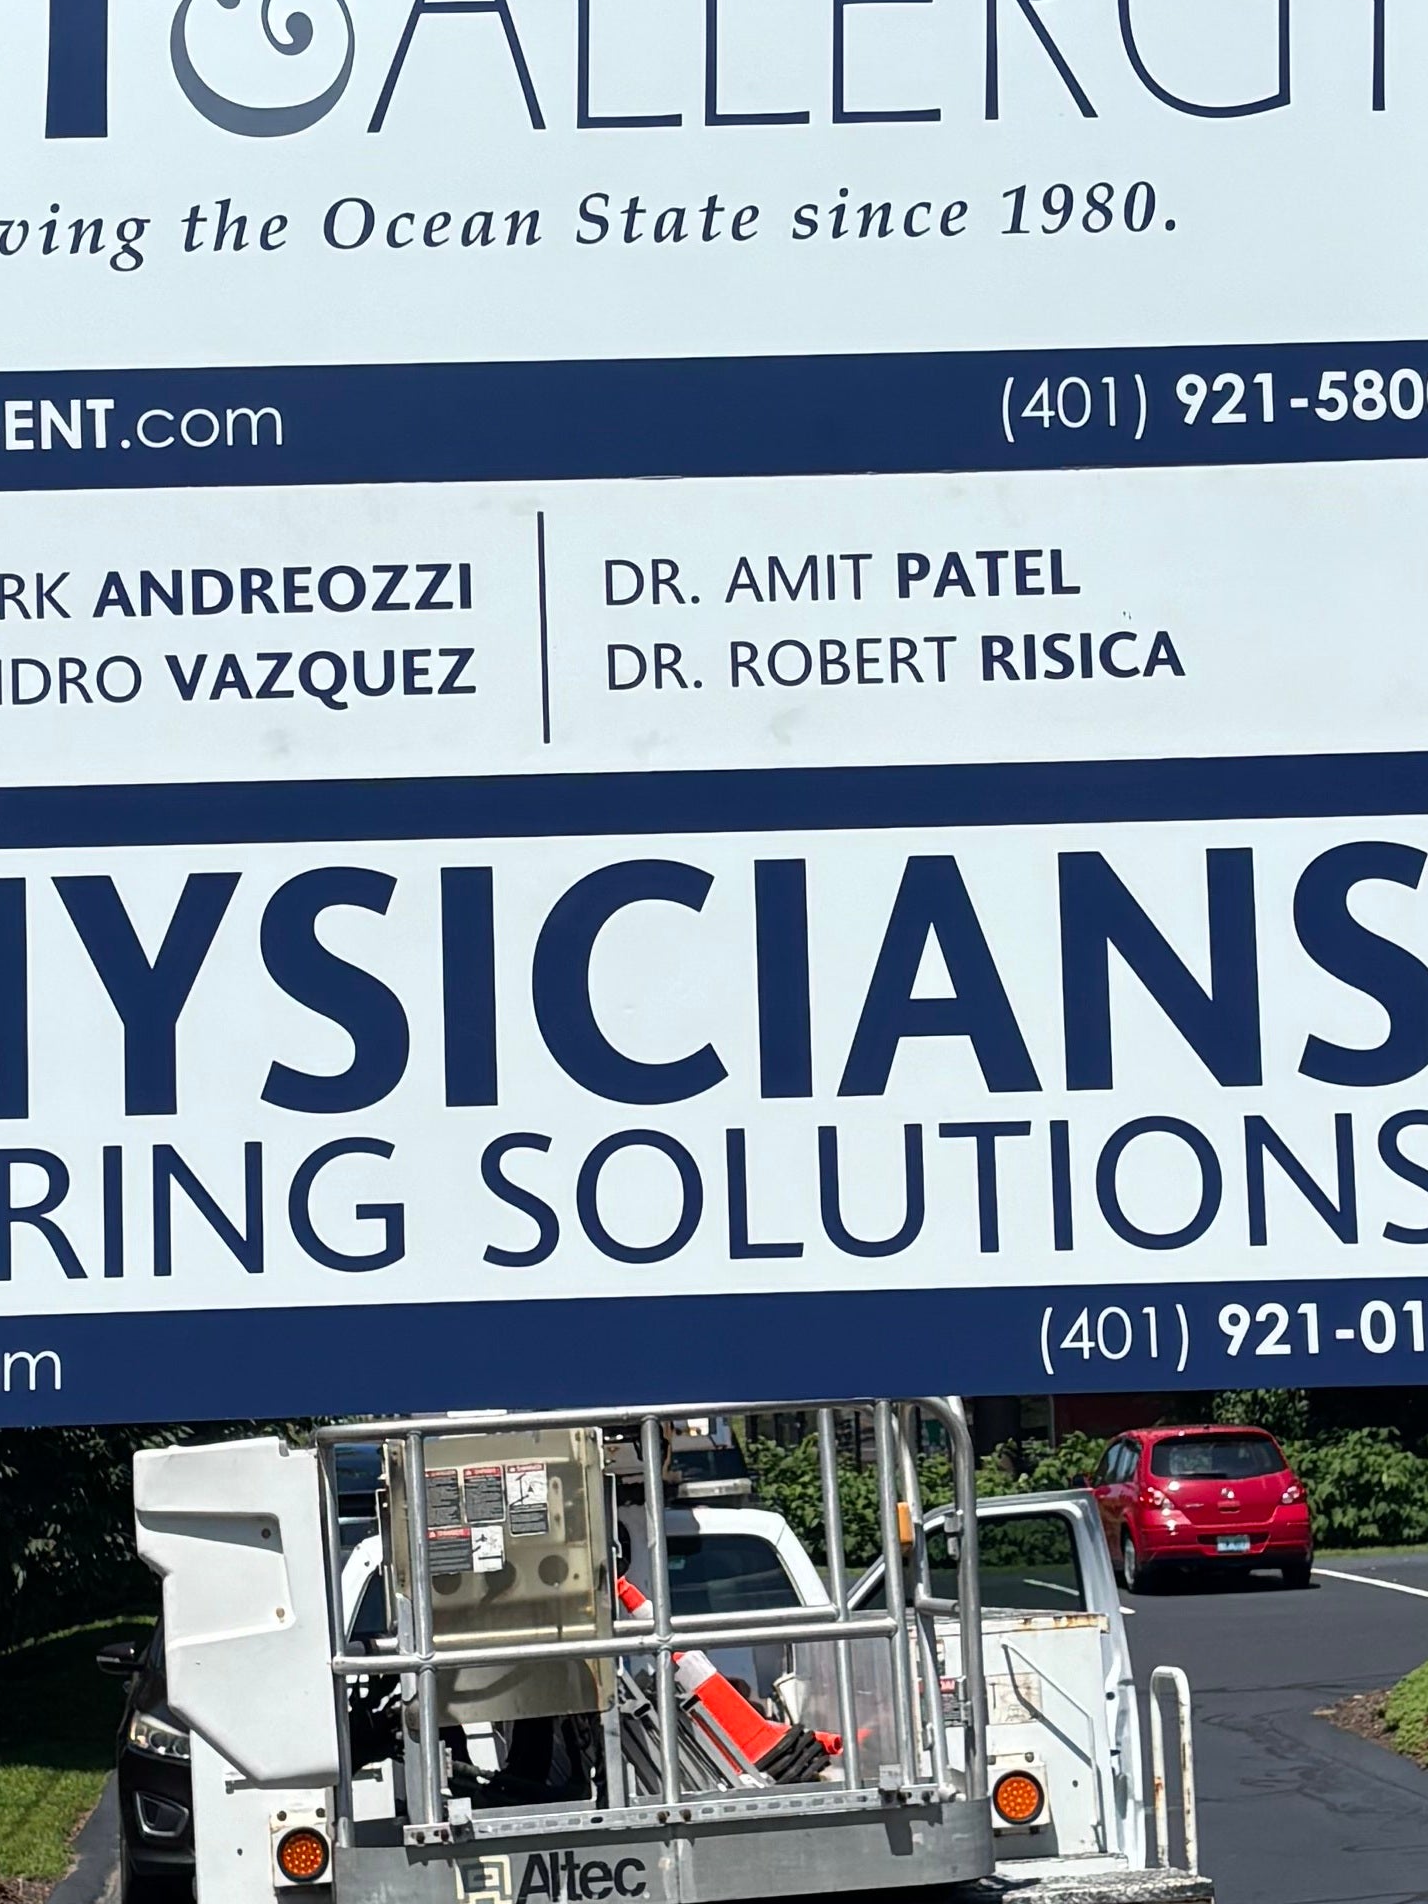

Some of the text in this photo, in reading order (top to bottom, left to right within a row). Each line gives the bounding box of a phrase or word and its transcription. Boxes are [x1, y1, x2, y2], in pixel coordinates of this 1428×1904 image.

[180, 197, 288, 253] the
[323, 197, 542, 250] Ocean
[575, 192, 760, 245] State
[791, 187, 969, 240] since
[1001, 180, 1176, 235] 1980.
[1002, 373, 1147, 443] (401)
[92, 562, 472, 619] ANDREOZZI
[604, 548, 1081, 606] DR. AMIT PATEL
[164, 647, 477, 711] VAZQUEZ
[607, 630, 1187, 691] DR. ROBERT RISICA
[1041, 1303, 1189, 1375] (401)
